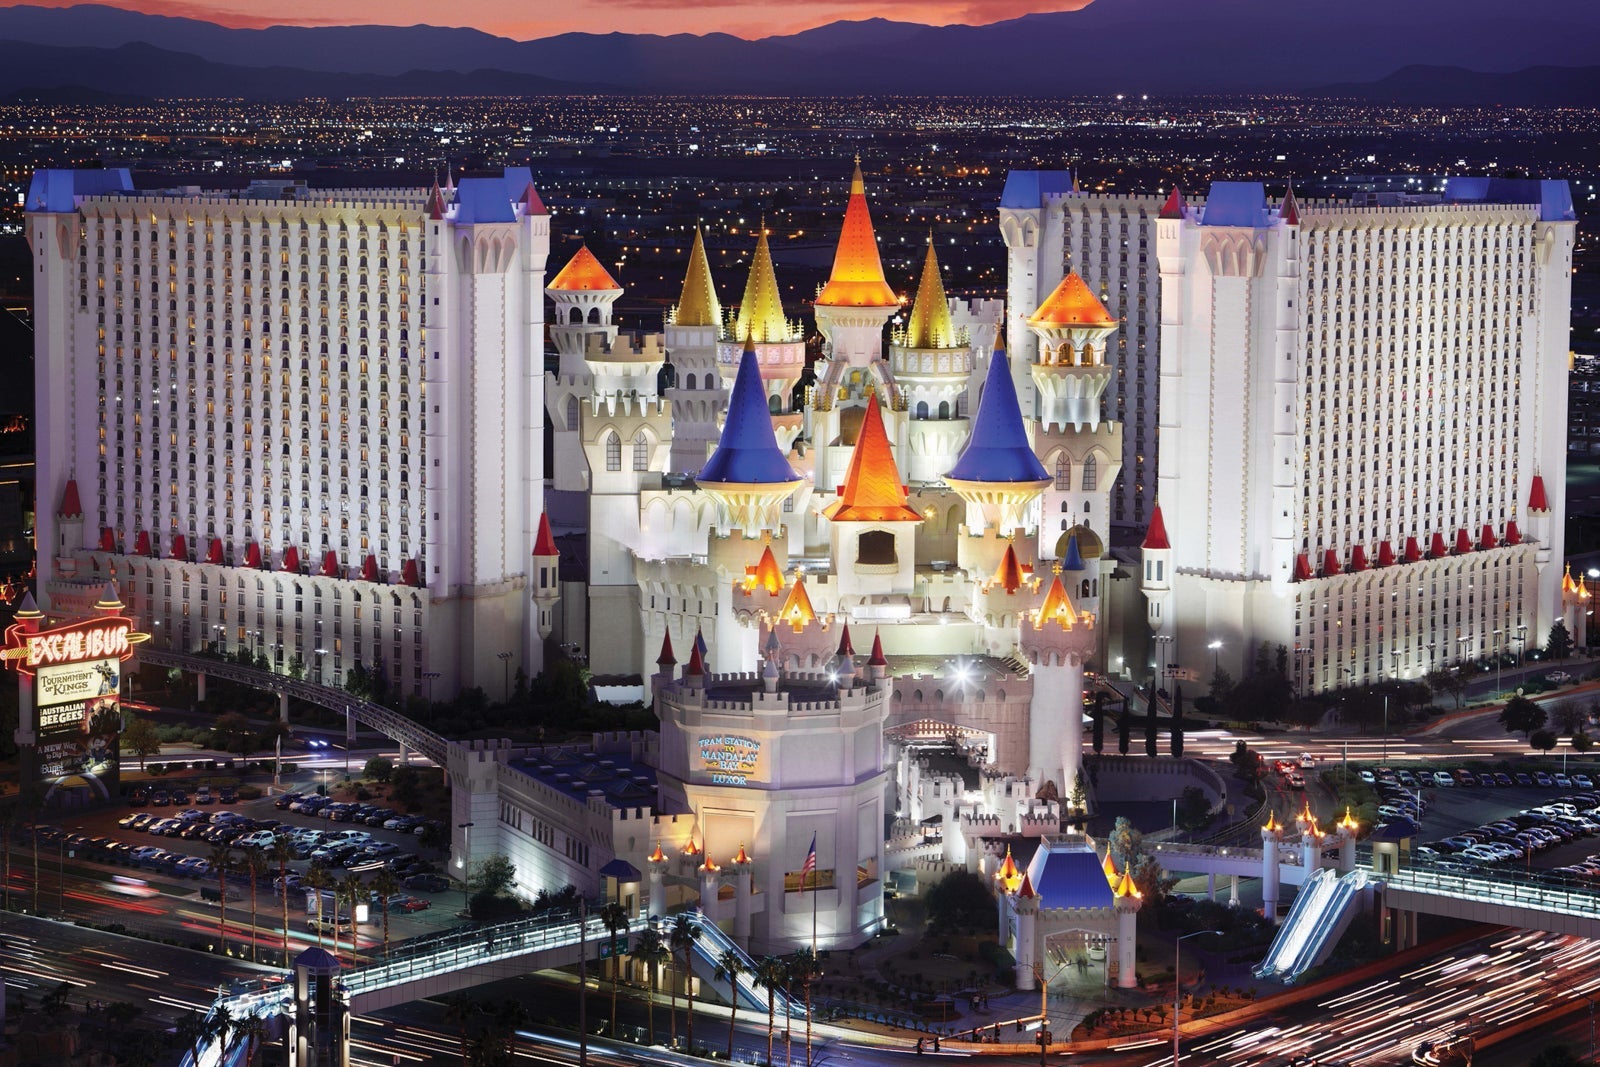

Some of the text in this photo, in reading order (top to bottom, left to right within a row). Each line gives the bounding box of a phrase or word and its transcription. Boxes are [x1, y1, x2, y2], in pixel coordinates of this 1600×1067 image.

[31, 626, 128, 665] EXCALIBUR
[42, 702, 86, 715] AUSTRALIAN
[40, 713, 58, 727] BEE
[58, 710, 83, 723] GEES
[37, 746, 43, 754] A
[44, 743, 62, 753] NEW
[699, 736, 760, 751] TRAM STATION
[702, 751, 757, 762] MANDALAY
[720, 761, 738, 770] BAY
[713, 774, 746, 784] LUXOR
